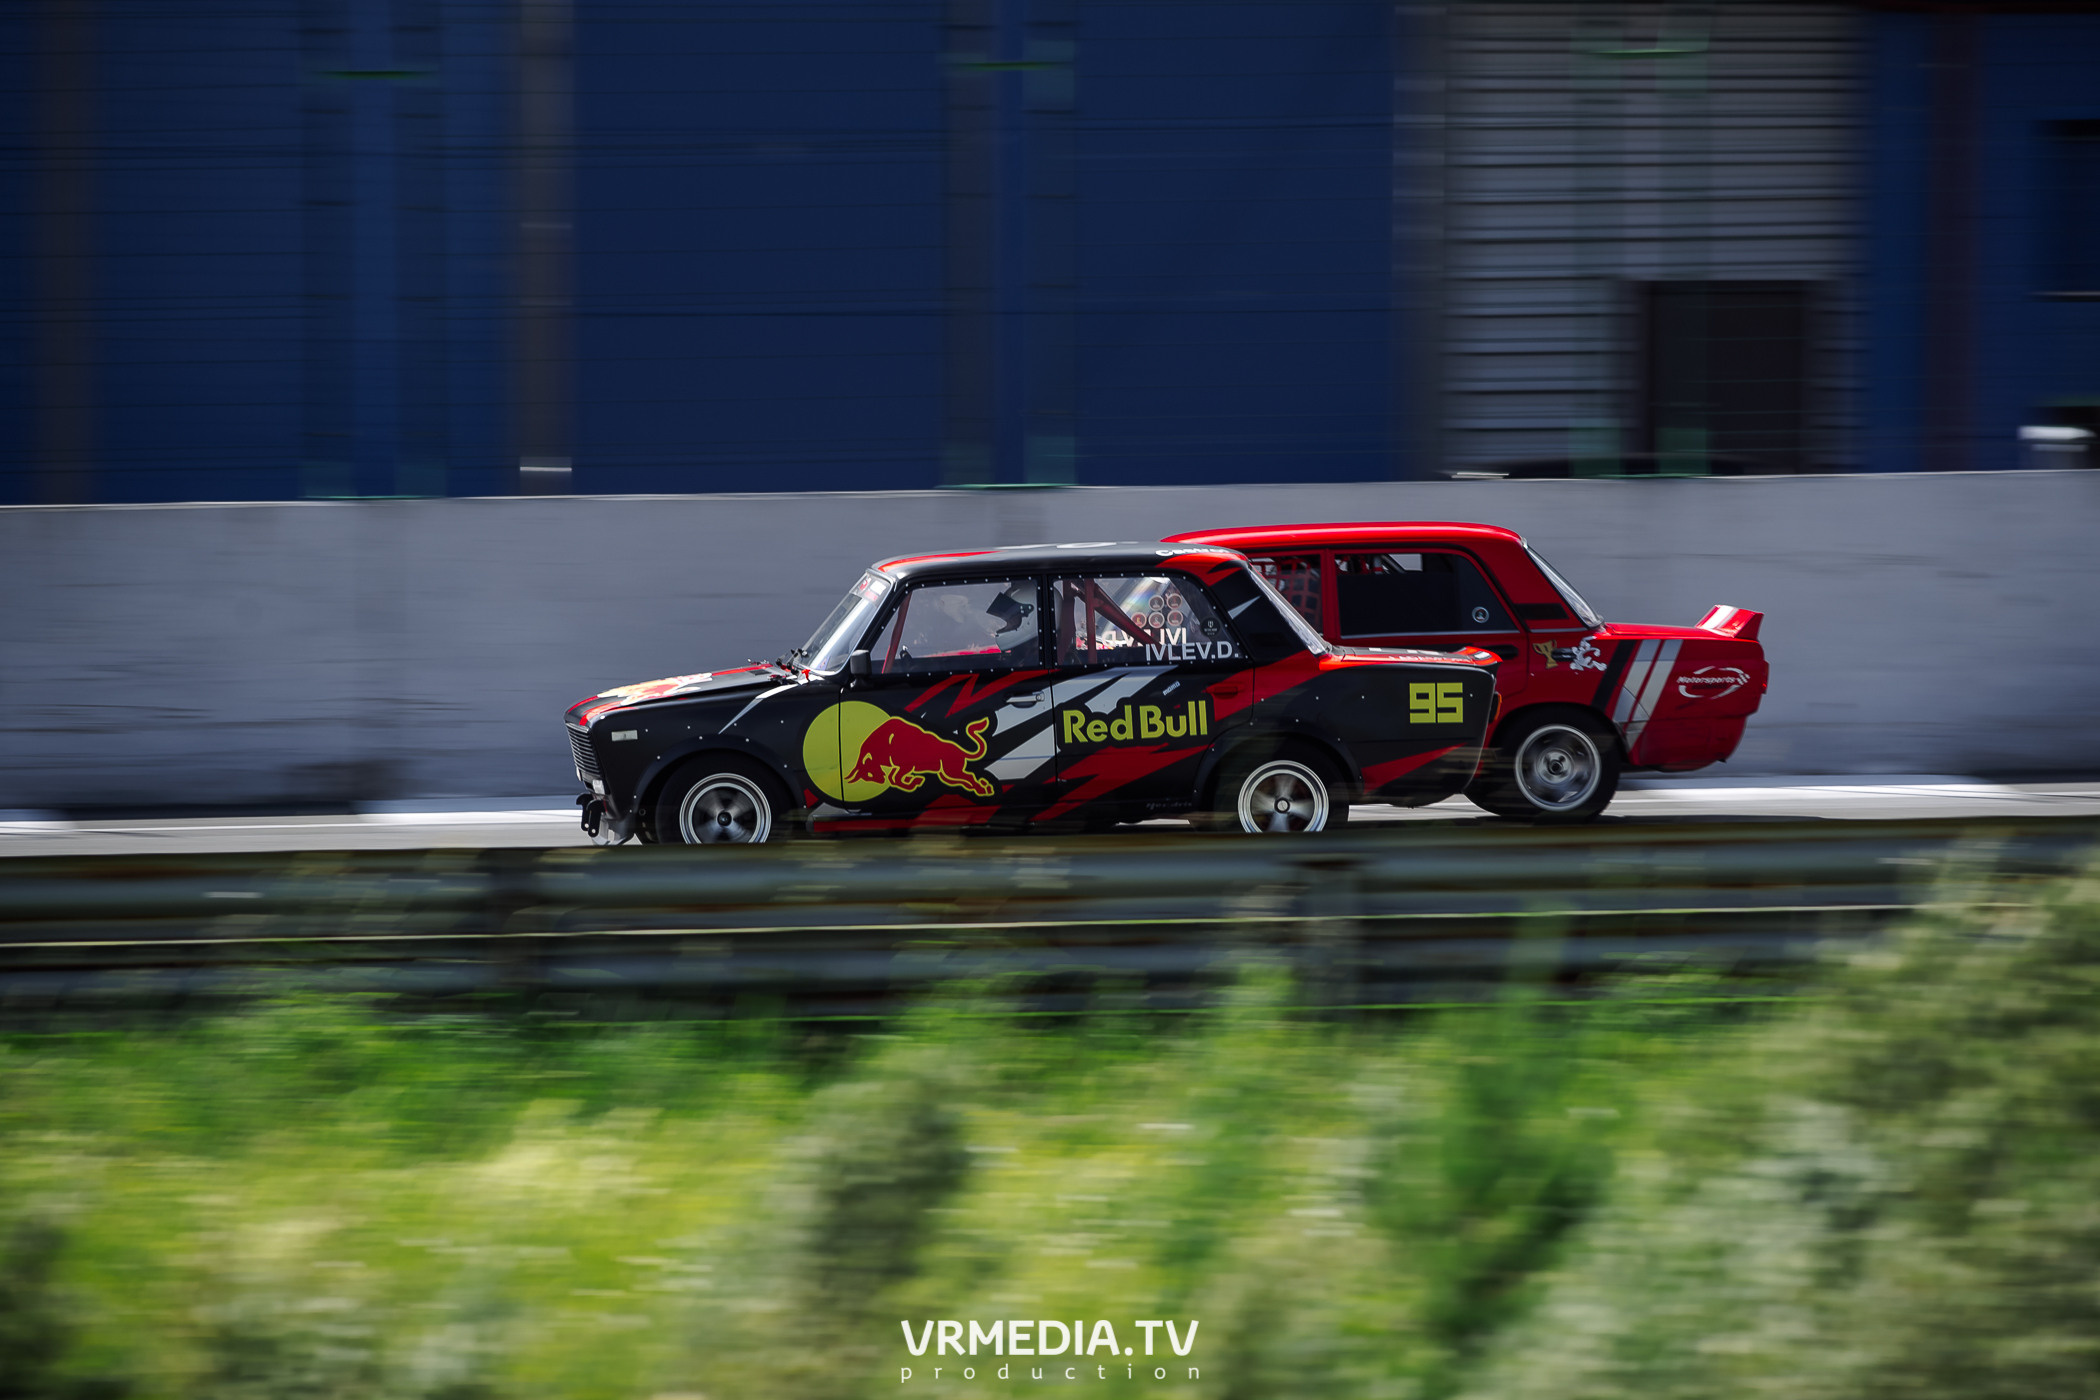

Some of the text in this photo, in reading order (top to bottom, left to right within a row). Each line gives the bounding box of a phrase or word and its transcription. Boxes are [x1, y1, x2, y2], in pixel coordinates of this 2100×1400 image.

[1145, 641, 1239, 661] IVLEV.D.
[1063, 700, 1208, 744] Red Bull
[1409, 682, 1463, 723] 95
